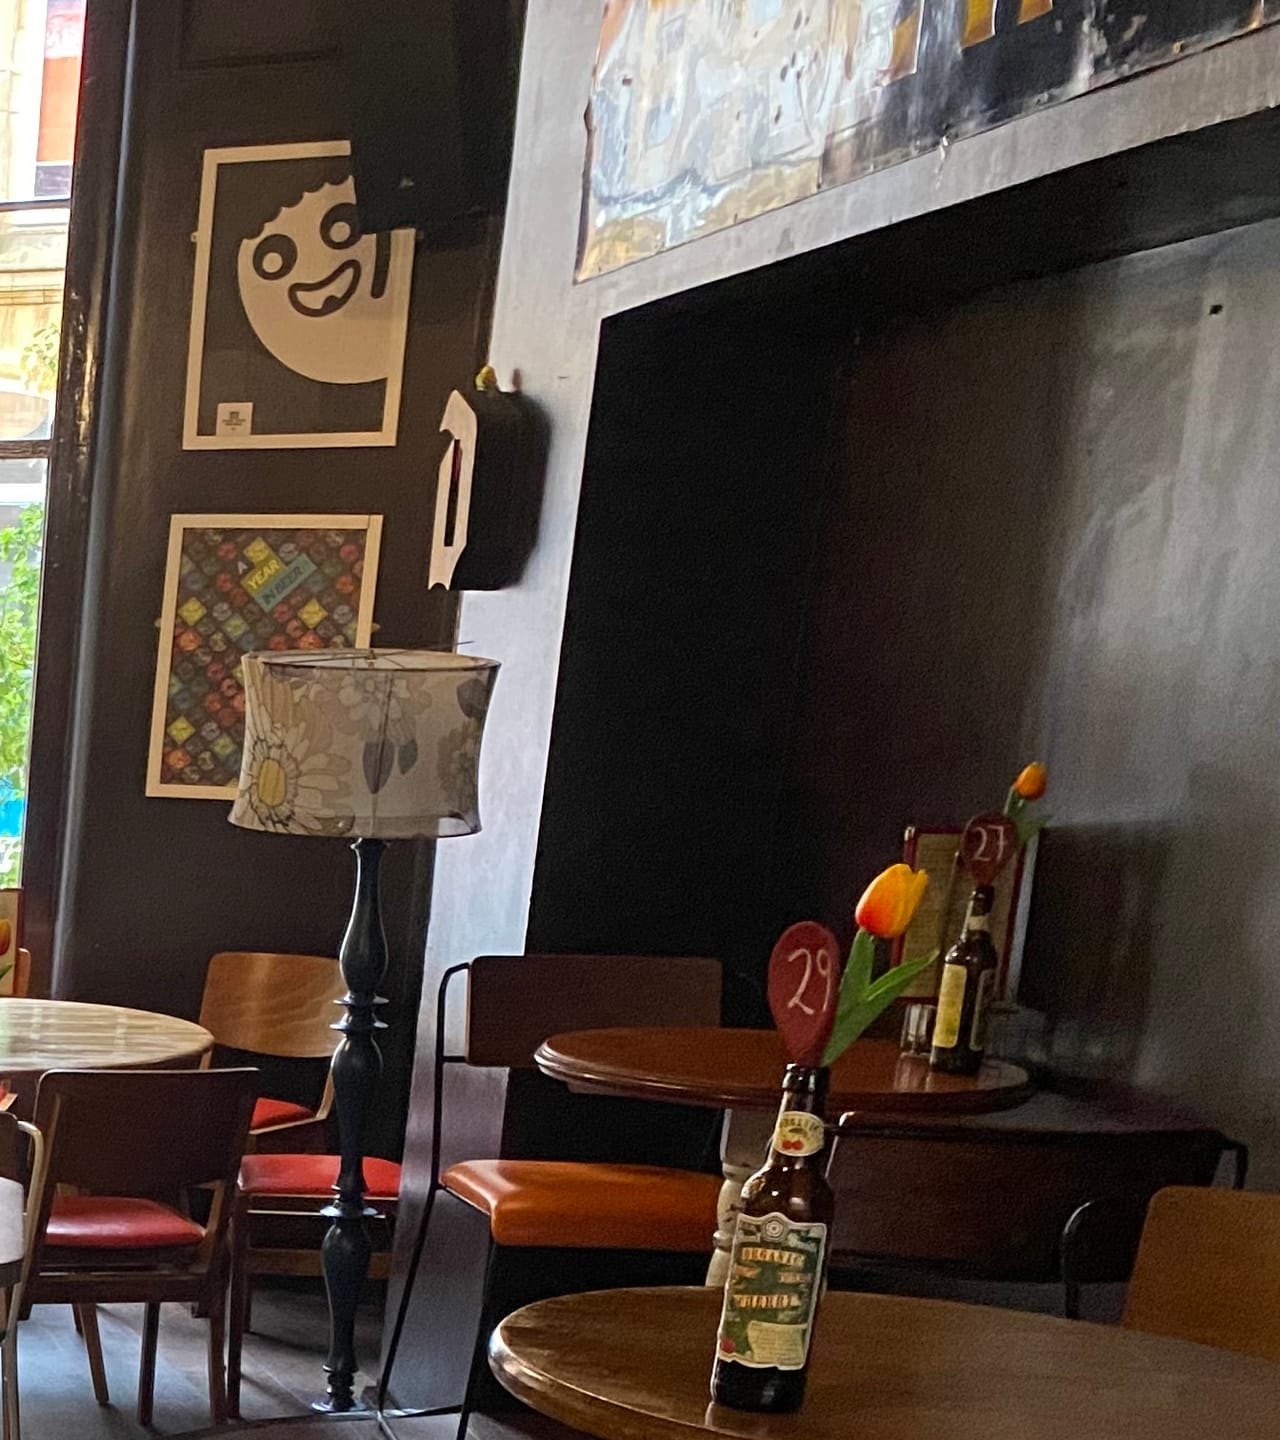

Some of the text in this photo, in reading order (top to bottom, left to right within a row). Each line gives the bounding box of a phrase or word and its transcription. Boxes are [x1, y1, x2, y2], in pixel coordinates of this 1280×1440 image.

[247, 559, 280, 589] YEAR
[974, 824, 1009, 863] 27
[787, 948, 834, 1017] 29
